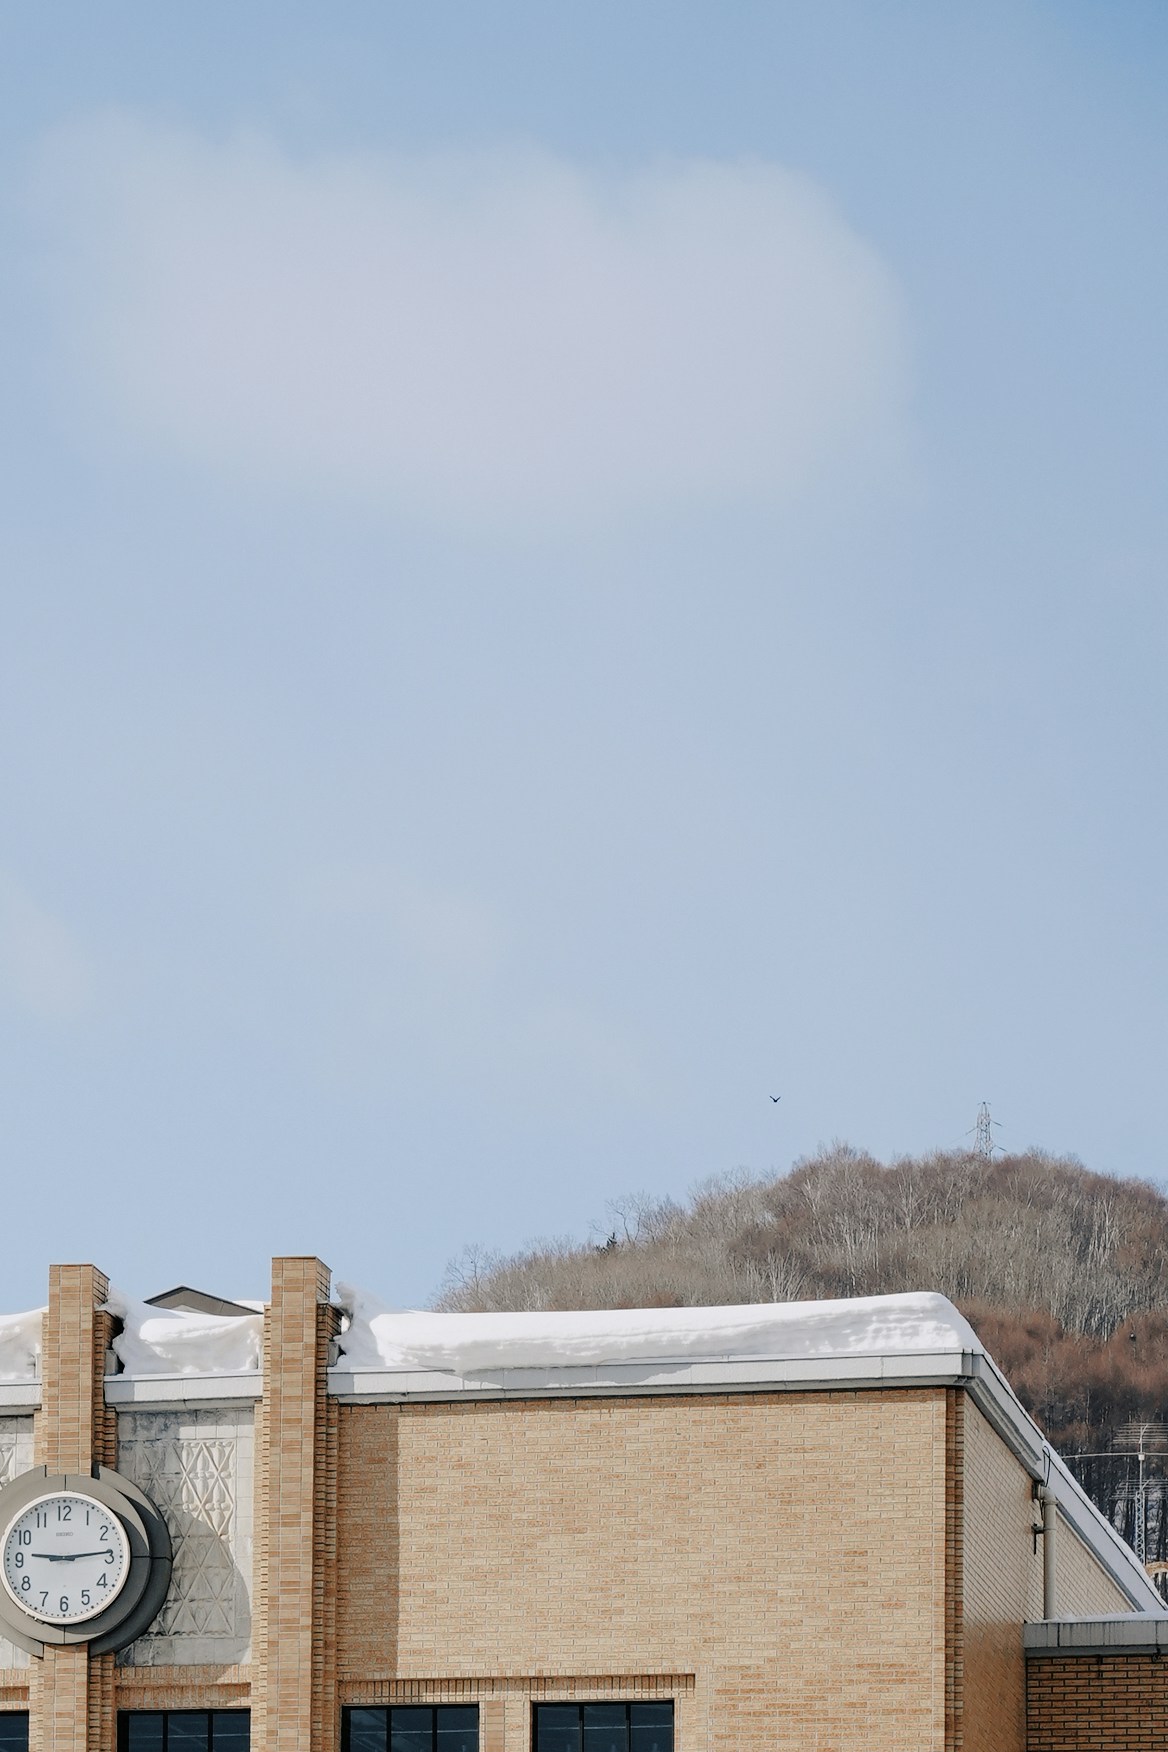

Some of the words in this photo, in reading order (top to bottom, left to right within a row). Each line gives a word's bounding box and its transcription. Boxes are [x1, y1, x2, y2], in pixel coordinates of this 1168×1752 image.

[36, 1512, 47, 1528] 11
[57, 1505, 72, 1522] 12
[85, 1510, 90, 1526] 1
[18, 1529, 32, 1546] 10
[99, 1525, 109, 1541] 2
[15, 1552, 24, 1569] 9
[104, 1549, 115, 1565] 3
[21, 1575, 32, 1592] 8
[96, 1573, 108, 1589] 4
[39, 1591, 49, 1607] 7
[59, 1596, 69, 1612] 6
[81, 1590, 91, 1606] 5
